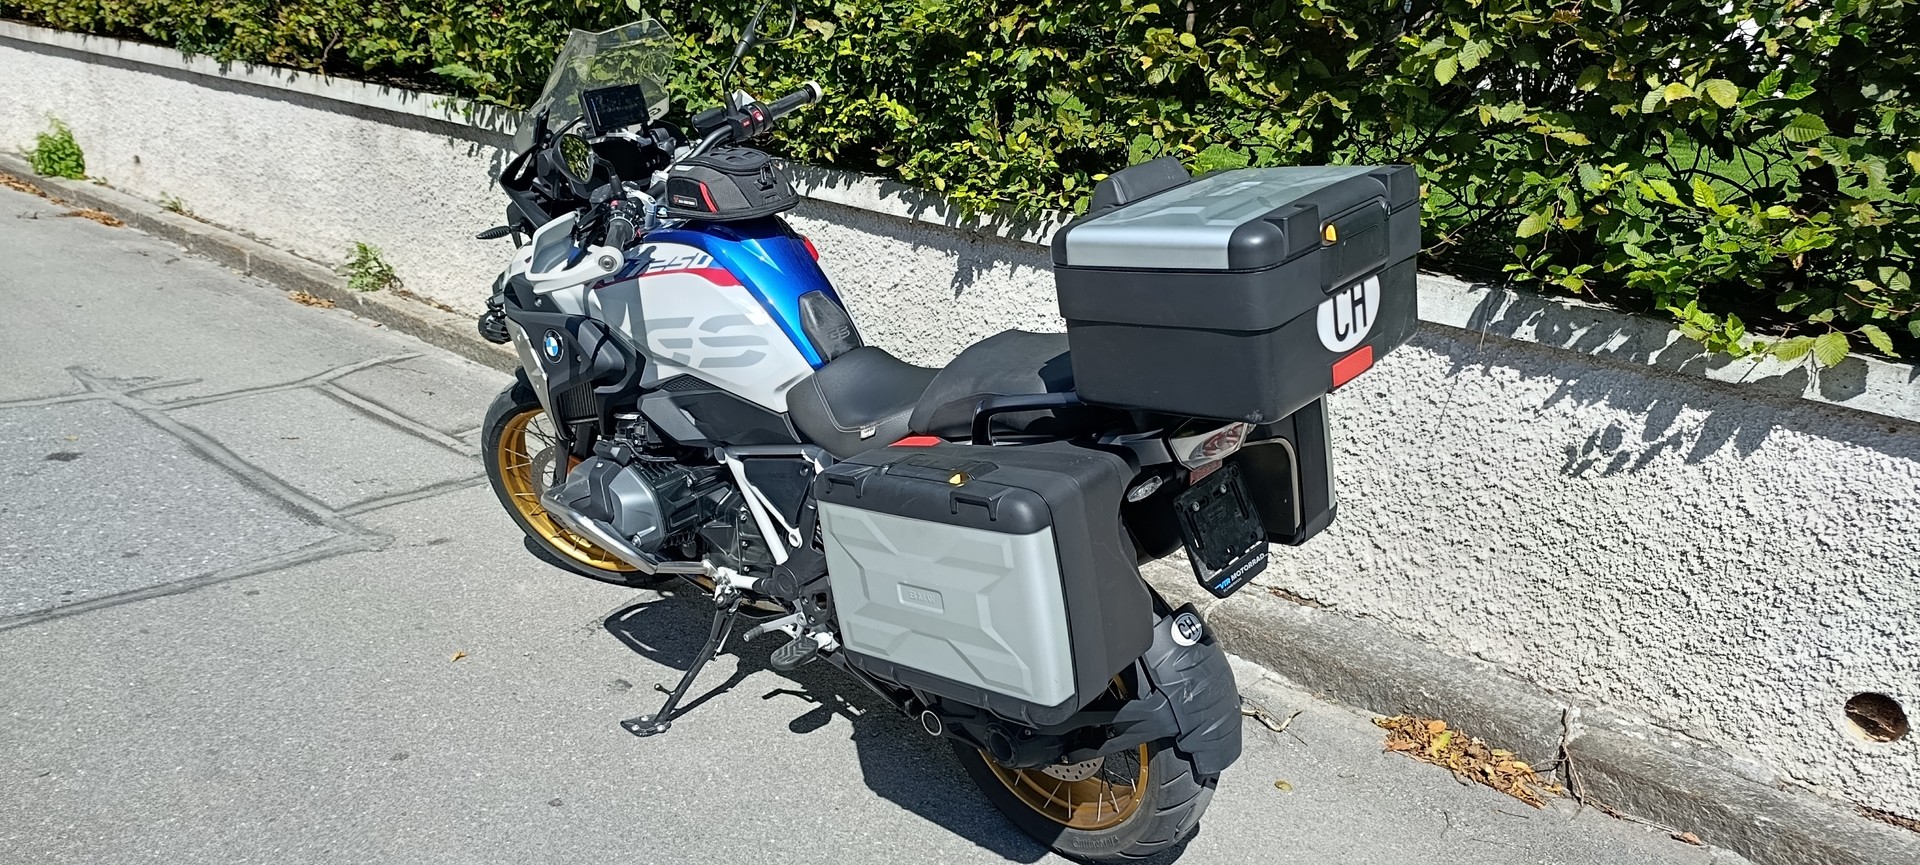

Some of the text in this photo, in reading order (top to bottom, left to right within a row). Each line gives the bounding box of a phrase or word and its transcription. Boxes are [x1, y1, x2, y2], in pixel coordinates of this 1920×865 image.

[1332, 281, 1368, 342] CH
[1230, 552, 1265, 582] MOTORRAD
[1178, 616, 1199, 640] CH
